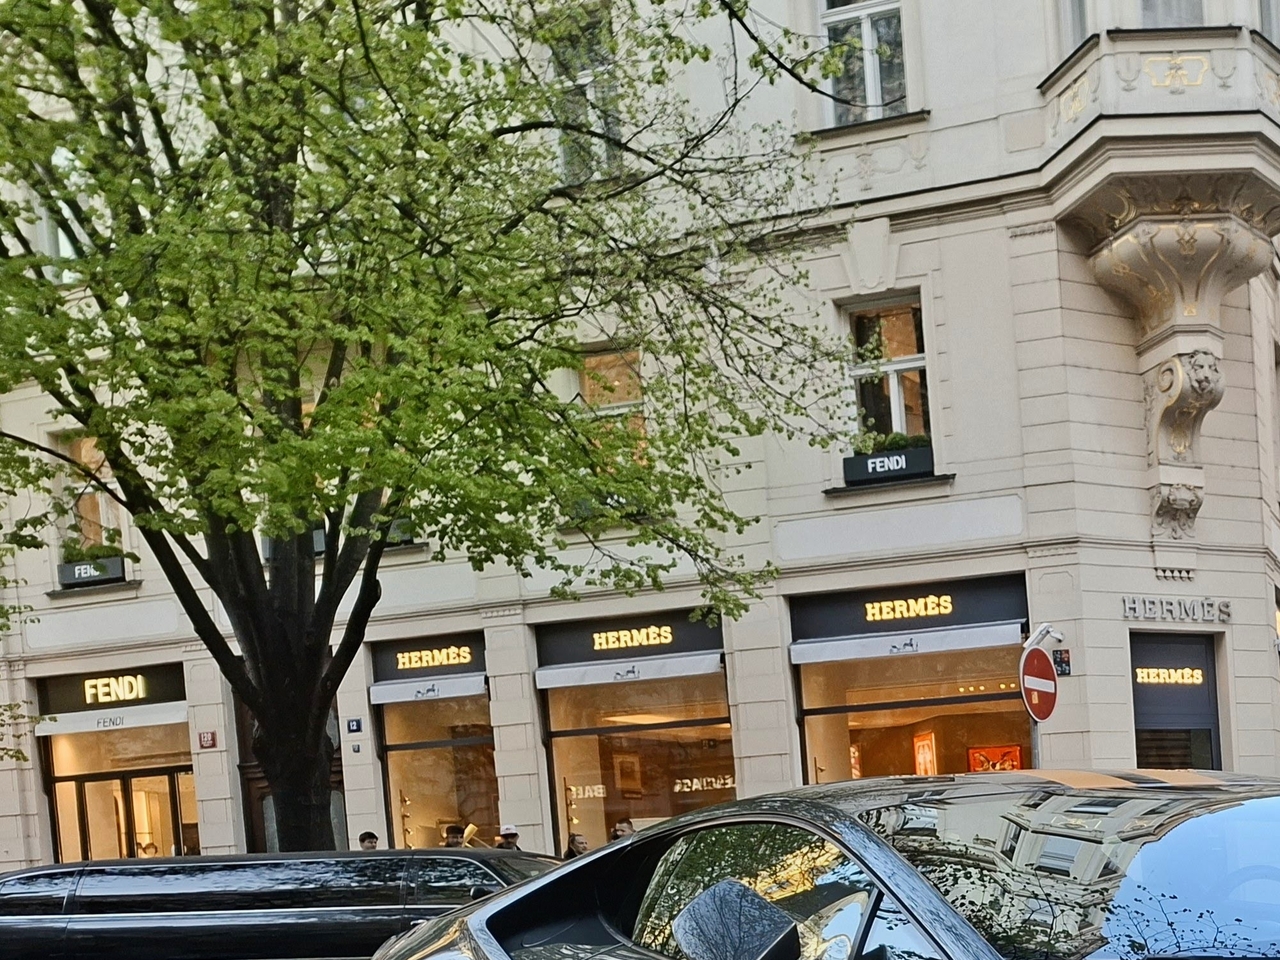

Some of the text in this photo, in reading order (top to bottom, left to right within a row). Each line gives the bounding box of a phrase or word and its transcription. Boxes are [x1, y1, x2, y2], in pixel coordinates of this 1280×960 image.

[867, 455, 907, 474] FENDI
[865, 594, 953, 622] HERMÈS
[1122, 595, 1231, 622] HERMÈS
[593, 625, 673, 650] HERMÈS
[396, 645, 472, 670] HERMÈS
[1135, 667, 1204, 685] HERMÈS
[84, 674, 146, 704] FENDI
[96, 716, 125, 728] FENDI
